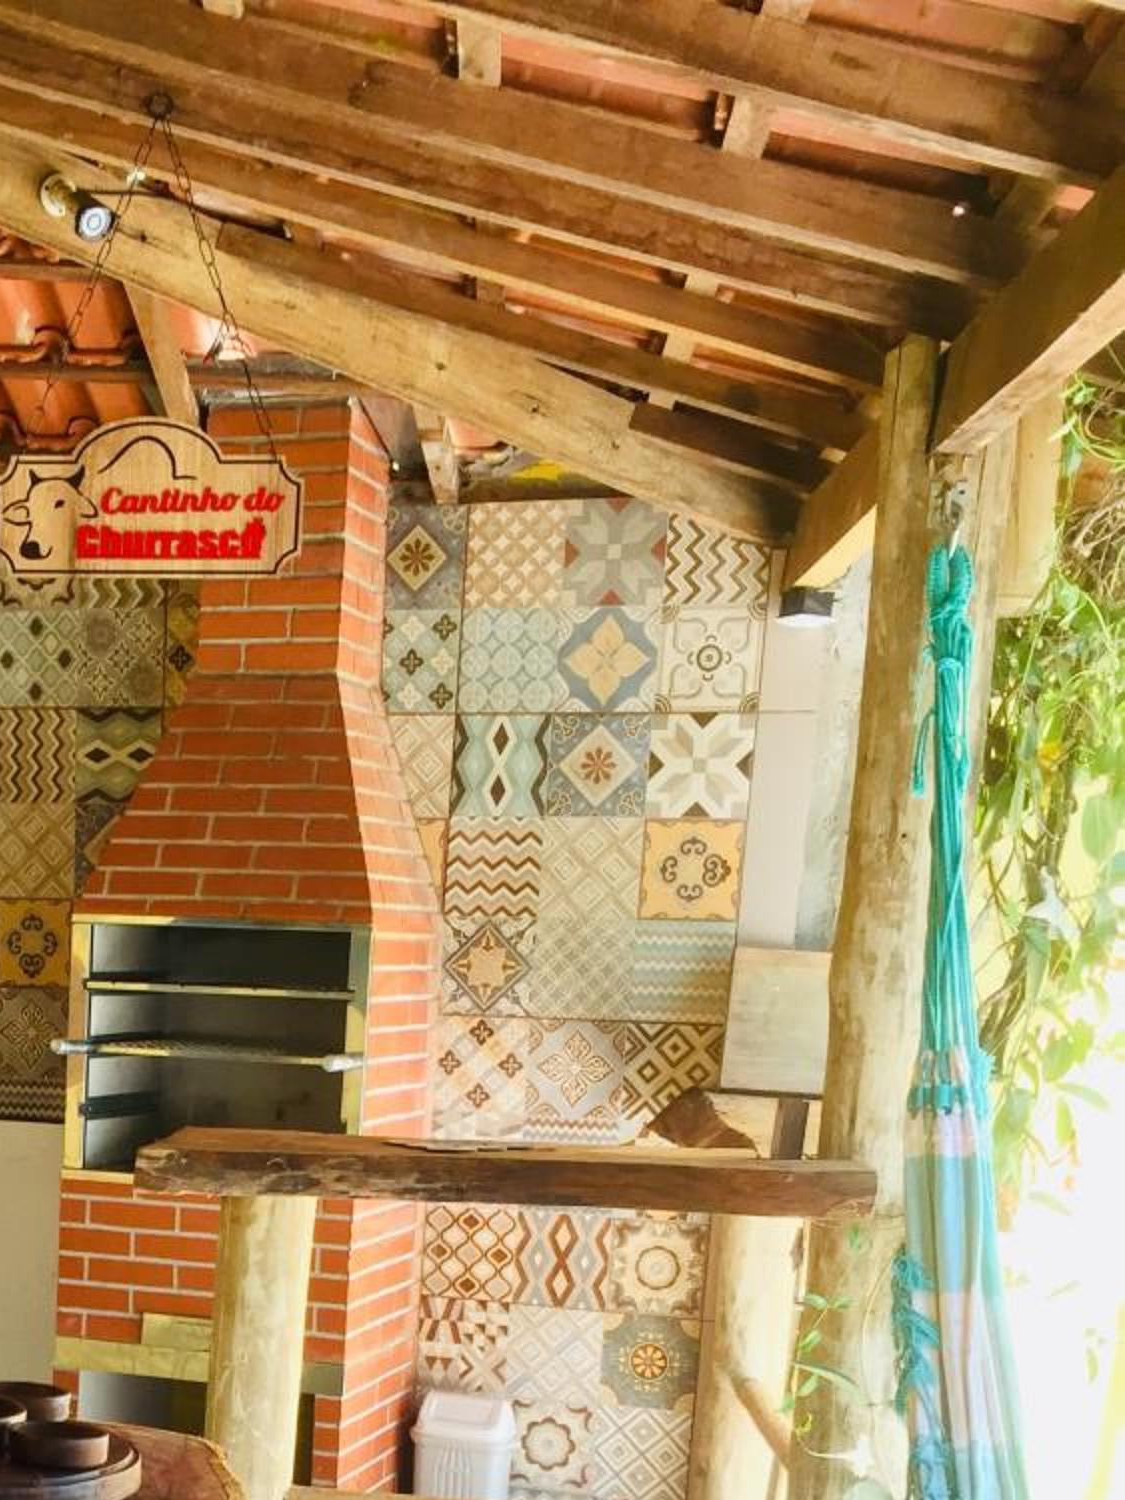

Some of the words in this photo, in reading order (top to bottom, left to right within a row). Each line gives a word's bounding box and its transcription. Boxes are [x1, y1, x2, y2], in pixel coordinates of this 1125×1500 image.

[101, 486, 240, 514] Cantinho
[244, 487, 285, 512] do
[76, 518, 266, 559] Churrasco
